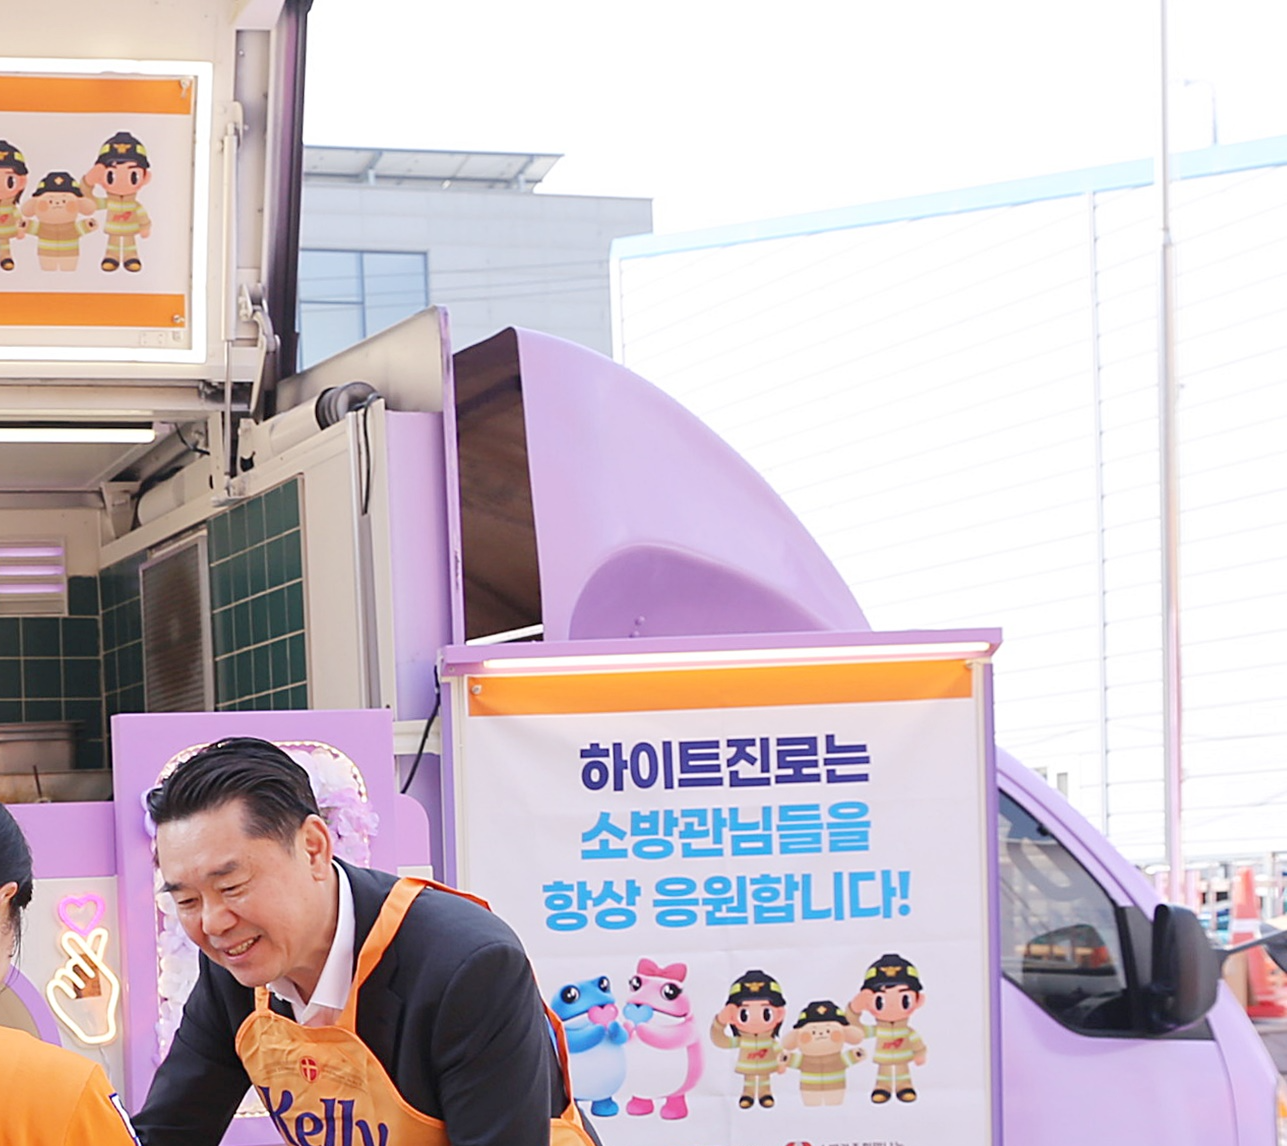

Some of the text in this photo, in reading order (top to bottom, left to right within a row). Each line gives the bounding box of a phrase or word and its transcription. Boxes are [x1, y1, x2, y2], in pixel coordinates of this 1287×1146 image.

[580, 734, 871, 792] 하이트진로는
[581, 801, 872, 860] 소방관님들을
[542, 870, 911, 932] 항상 응원합니다!
